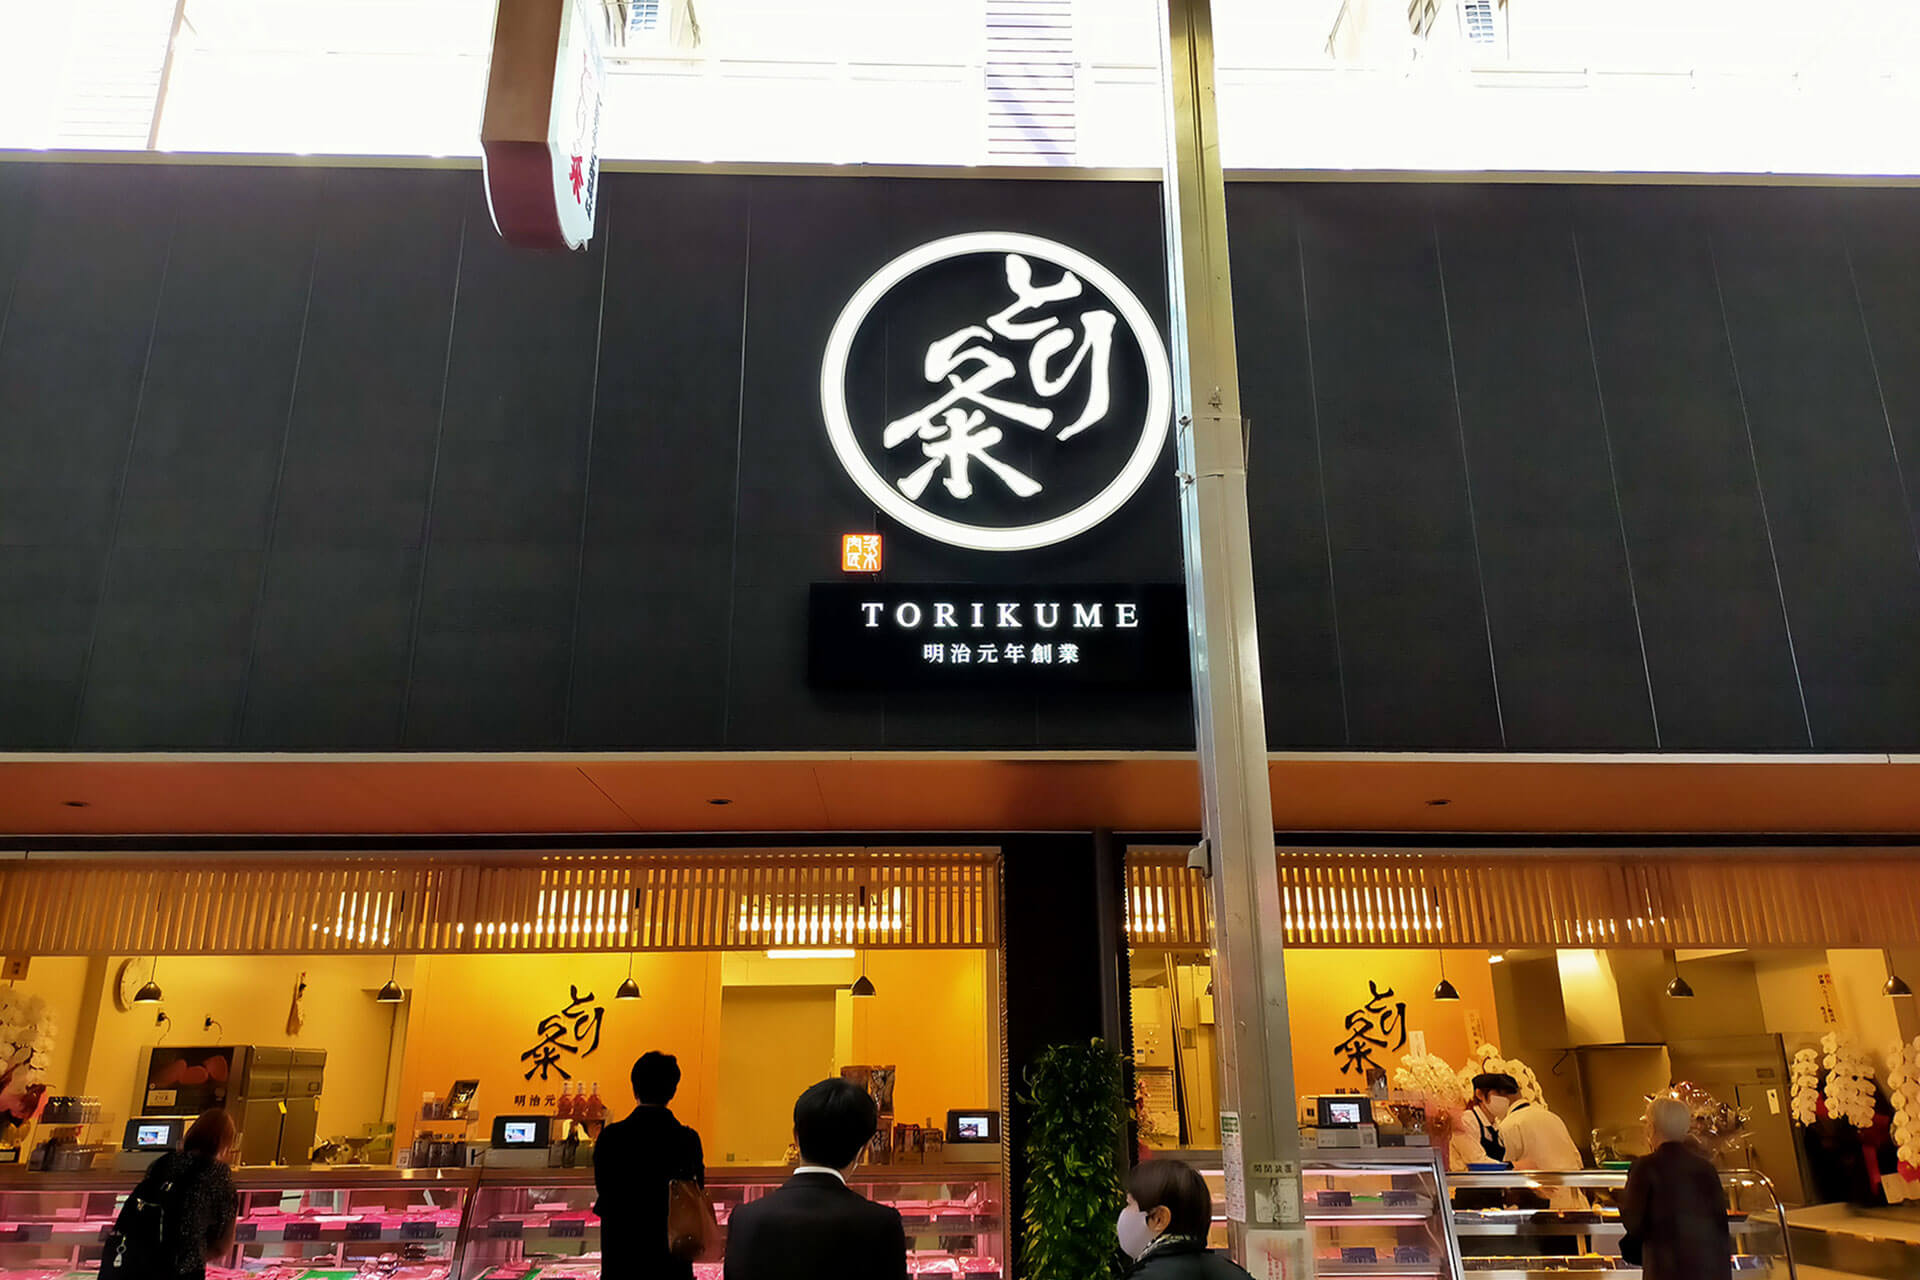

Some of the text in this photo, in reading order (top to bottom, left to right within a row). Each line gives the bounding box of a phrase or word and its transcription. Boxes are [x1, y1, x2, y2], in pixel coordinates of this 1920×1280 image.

[861, 602, 1139, 629] TORIKUME
[922, 642, 1081, 665] 明治元年創業
